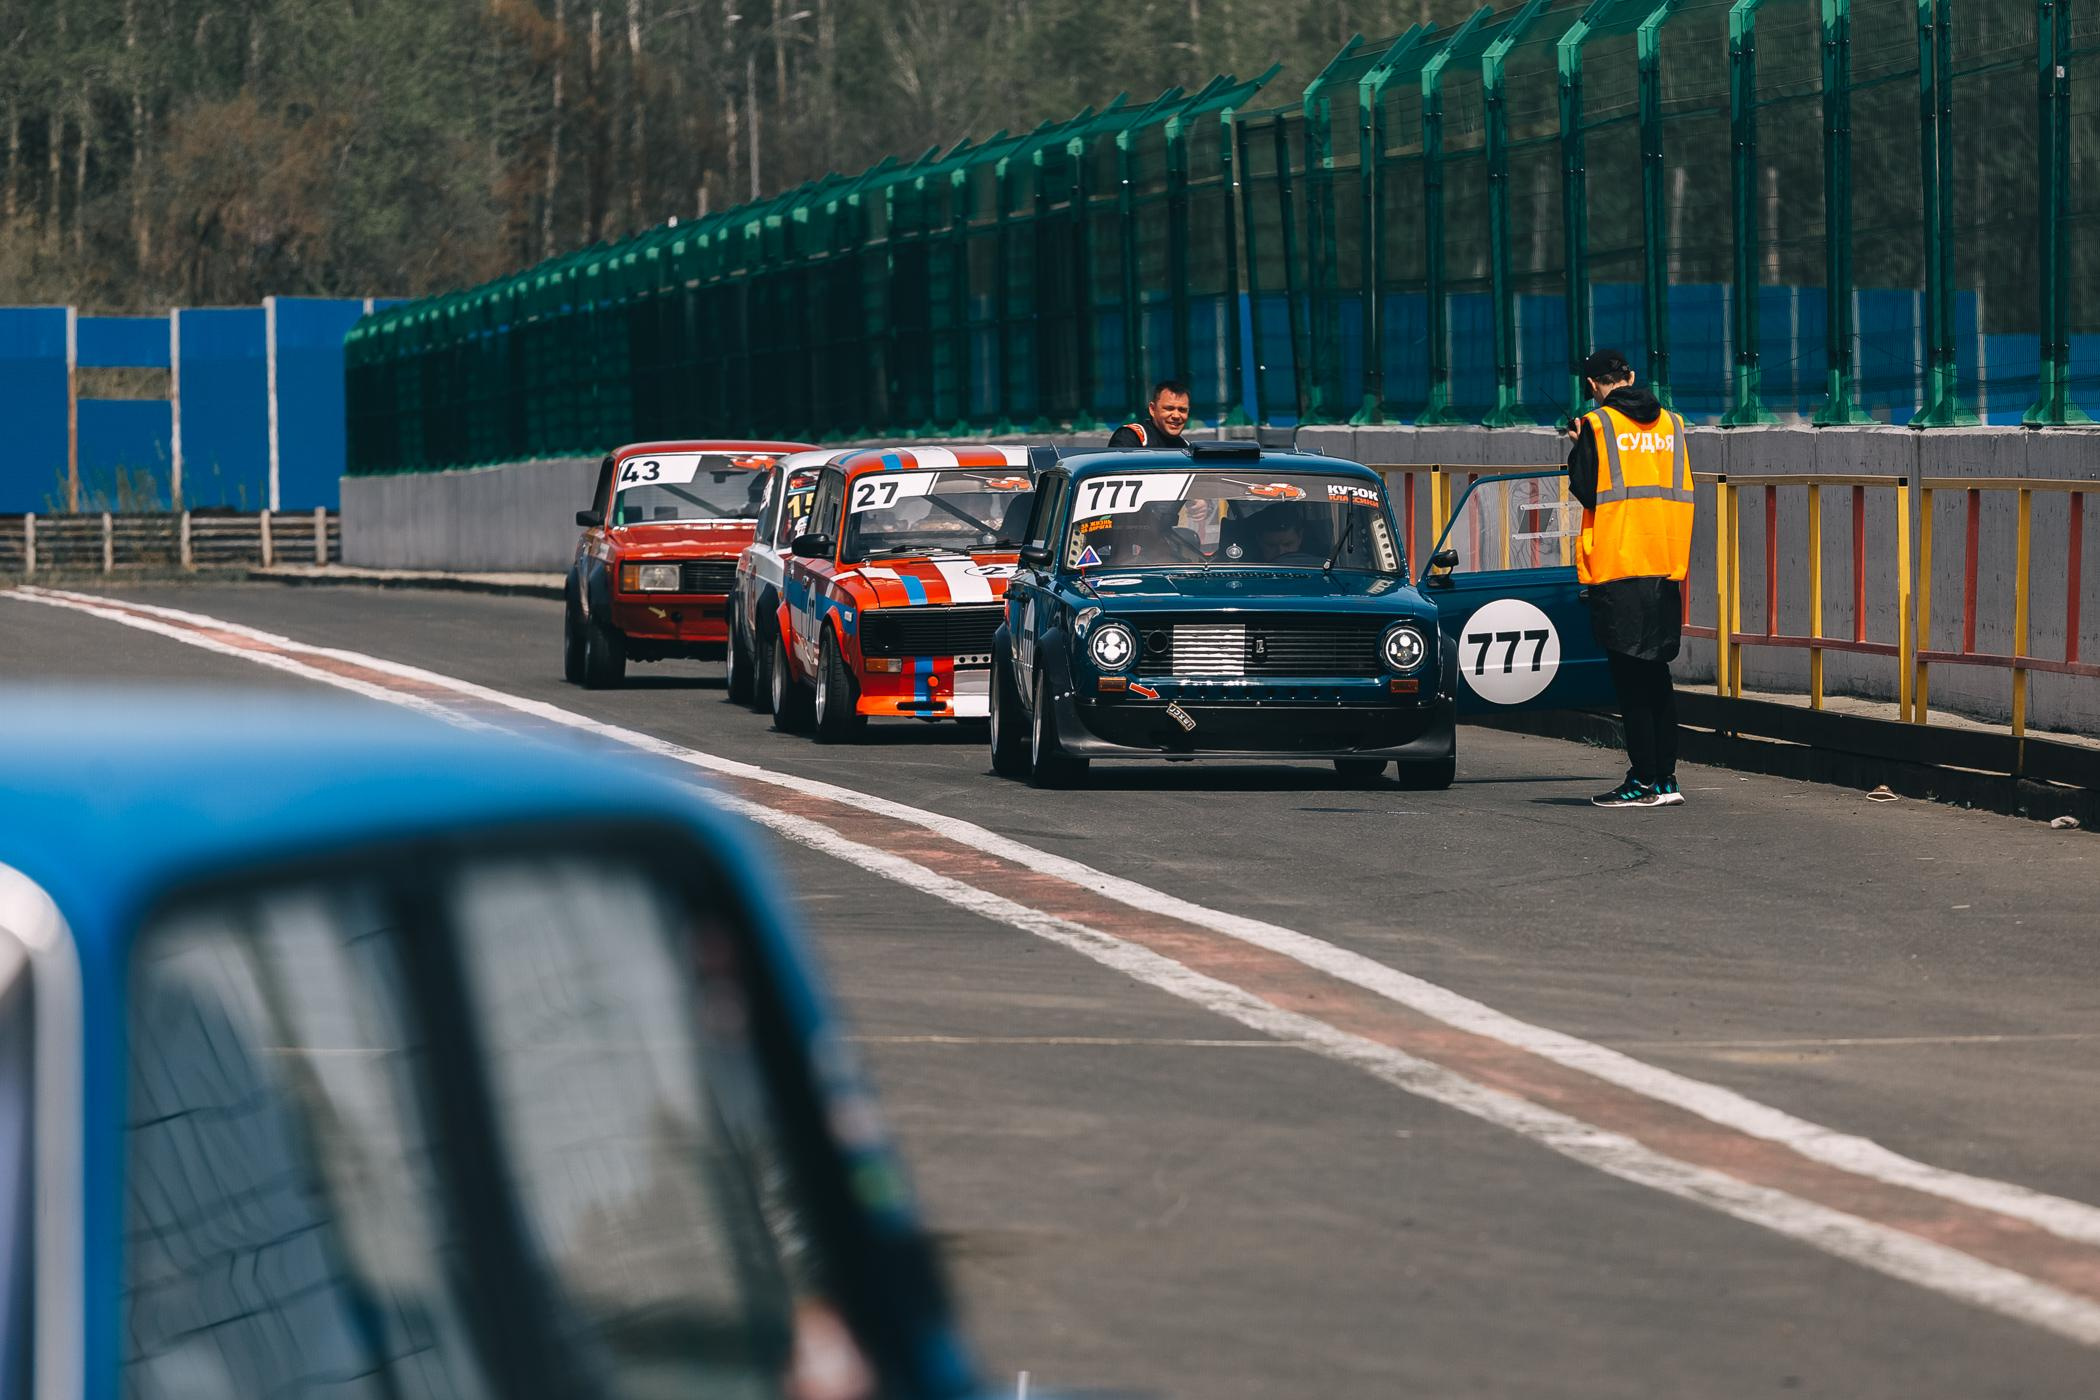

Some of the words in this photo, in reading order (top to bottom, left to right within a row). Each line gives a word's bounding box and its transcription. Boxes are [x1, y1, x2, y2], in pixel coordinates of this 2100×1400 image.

[1616, 432, 1675, 454] СУДЬЯ
[621, 460, 661, 483] 43
[856, 481, 899, 508] 27
[1087, 480, 1143, 511] 777
[1467, 628, 1550, 677] 777
